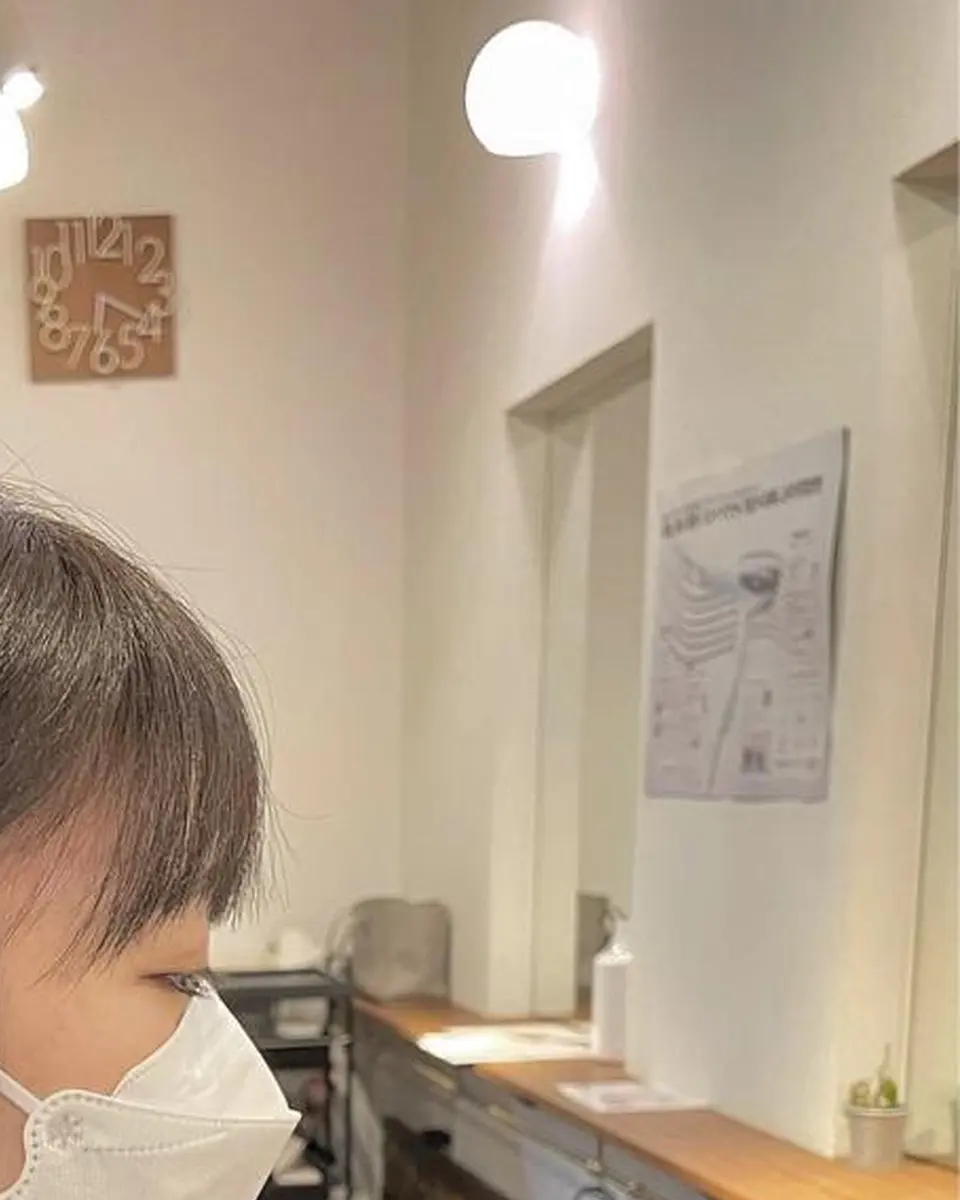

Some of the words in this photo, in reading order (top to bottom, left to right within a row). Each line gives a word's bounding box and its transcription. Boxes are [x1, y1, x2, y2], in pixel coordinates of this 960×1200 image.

[87, 215, 124, 260] 12
[136, 237, 166, 285] 2
[37, 304, 70, 351] 8
[67, 322, 91, 369] 7
[118, 322, 146, 370] 5
[90, 328, 120, 375] 6
